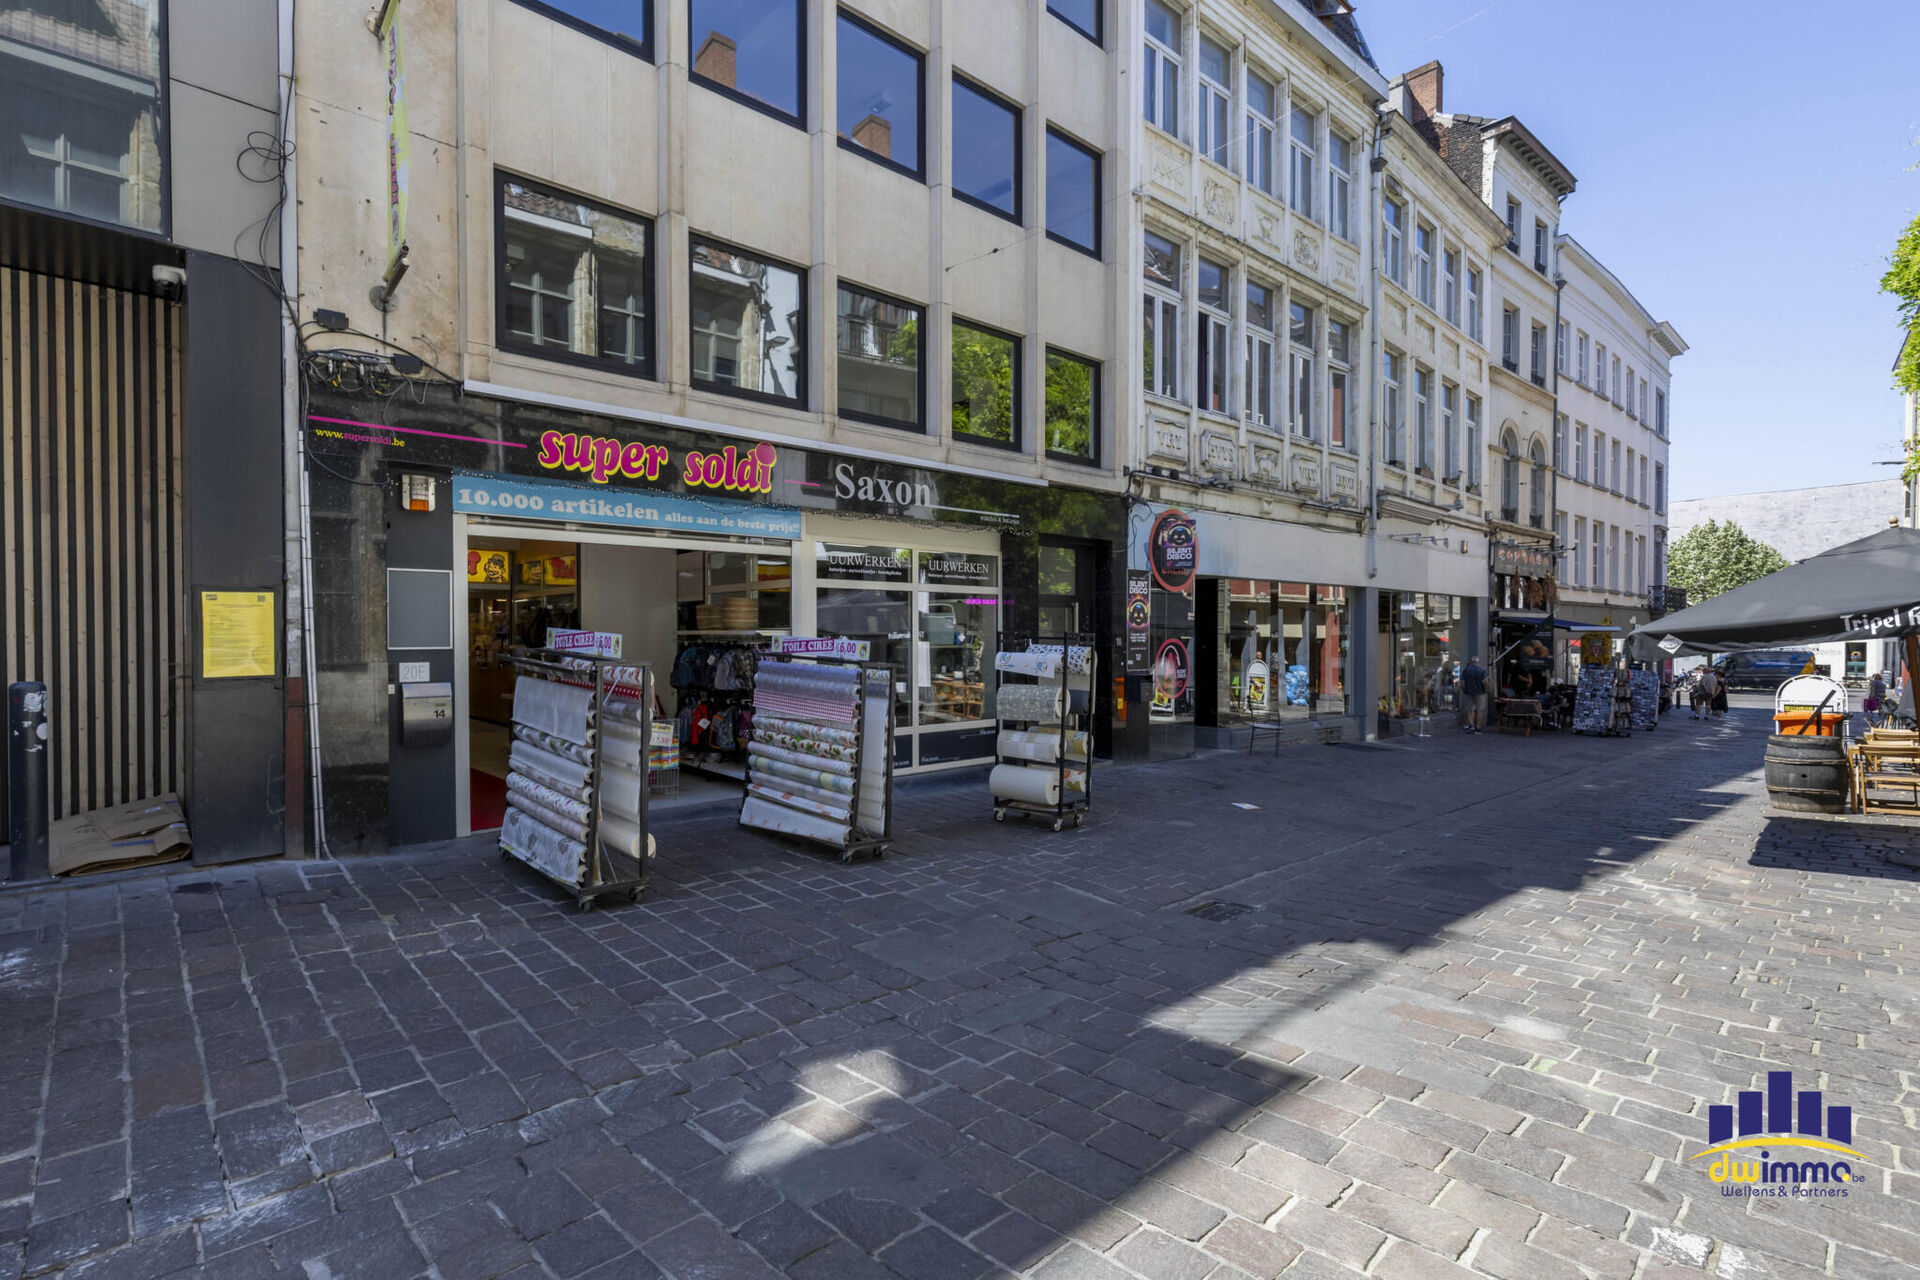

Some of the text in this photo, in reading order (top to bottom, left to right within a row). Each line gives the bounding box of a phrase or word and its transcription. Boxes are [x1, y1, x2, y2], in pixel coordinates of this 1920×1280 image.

[315, 429, 405, 447] www.supersoldi.be
[538, 430, 777, 494] super soldi
[835, 463, 930, 507] Saxon
[458, 488, 544, 511] 10.000
[551, 499, 659, 522] artikelen
[664, 512, 693, 524] alles
[696, 516, 718, 527] aan
[720, 516, 734, 528] de
[737, 518, 767, 531] beste
[829, 554, 901, 568] UURWERKEN
[928, 559, 990, 574] UURWERKEN
[1129, 580, 1148, 588] SILENT
[1129, 587, 1148, 595] DISCO
[1840, 608, 1902, 635] Tripel
[783, 641, 806, 653] TOILE
[432, 708, 445, 719] 14
